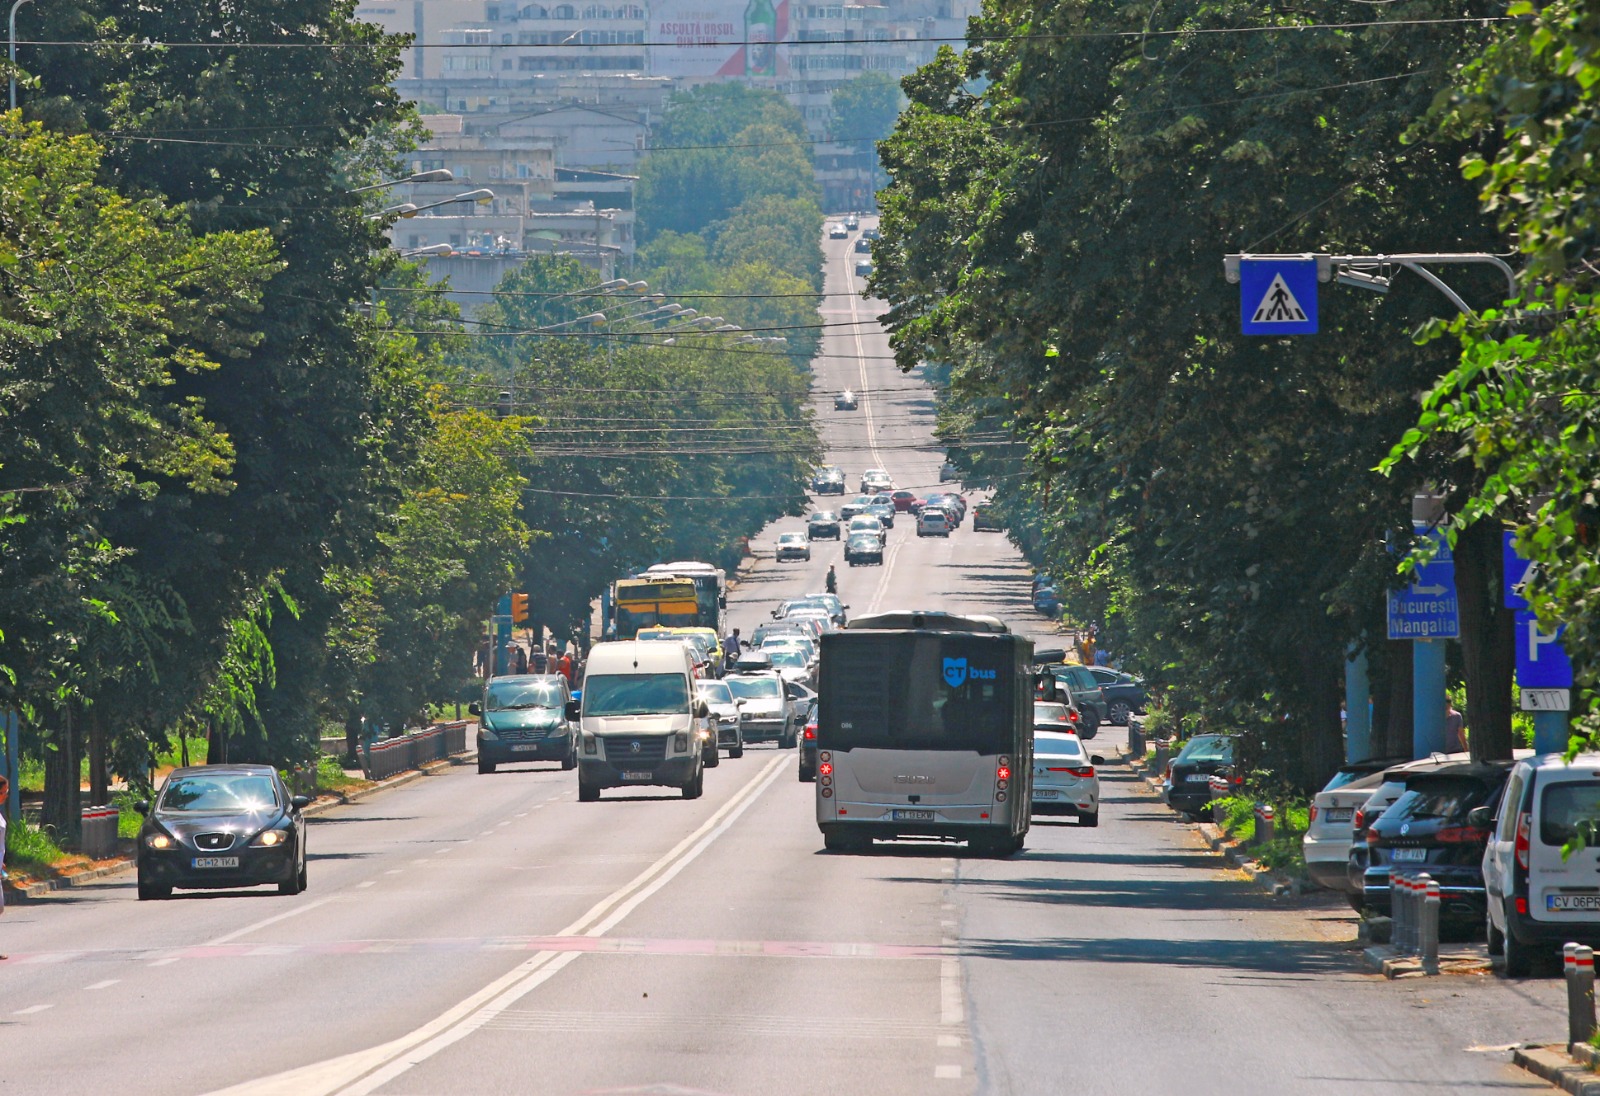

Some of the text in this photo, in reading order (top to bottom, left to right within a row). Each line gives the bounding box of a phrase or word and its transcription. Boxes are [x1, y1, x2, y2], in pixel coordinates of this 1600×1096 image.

[704, 23, 735, 35] URSUL
[676, 36, 718, 48] DIN TINE
[1391, 618, 1456, 636] Mangalia
[1529, 620, 1557, 661] P
[945, 666, 996, 679] CT bus
[893, 775, 935, 784] ISUZU
[897, 811, 907, 819] CT
[917, 811, 932, 819] EKW
[197, 859, 206, 867] CT
[1554, 896, 1569, 908] CV
